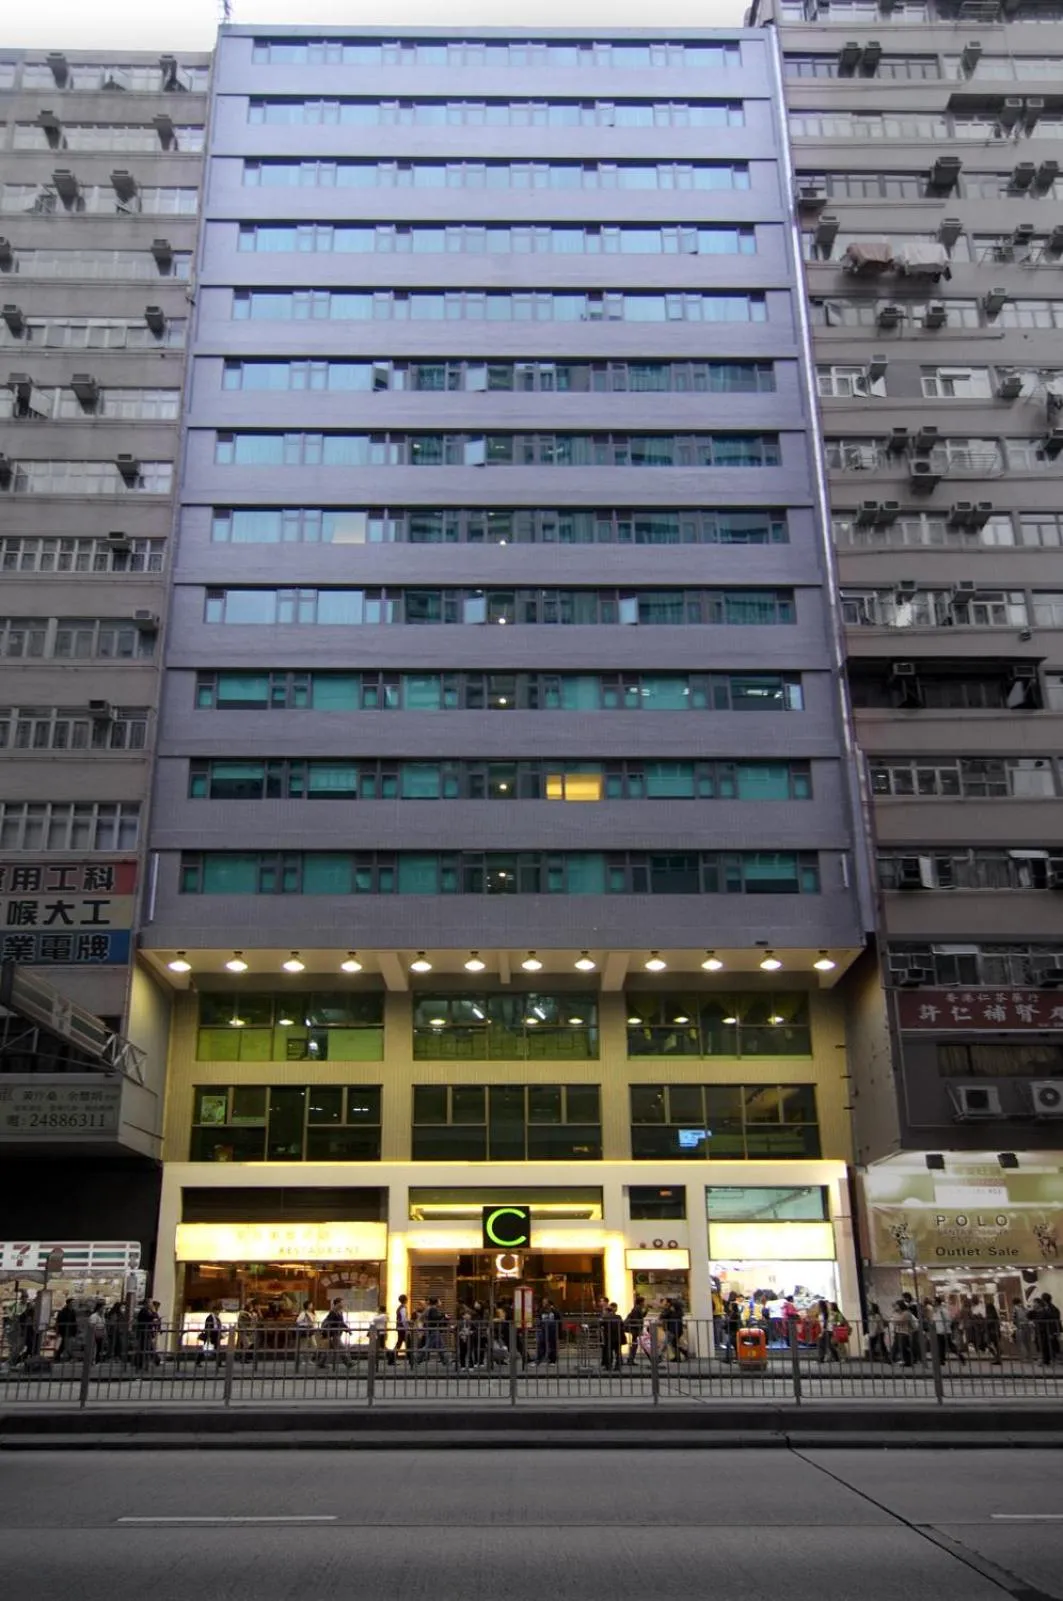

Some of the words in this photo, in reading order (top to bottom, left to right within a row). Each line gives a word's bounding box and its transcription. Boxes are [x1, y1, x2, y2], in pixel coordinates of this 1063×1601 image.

[0, 866, 114, 892] 用工科
[29, 1113, 105, 1127] 24886311
[486, 1208, 526, 1247] C
[936, 1215, 1007, 1226] POLO
[935, 1246, 980, 1256] Outlet
[988, 1246, 1019, 1256] Sale
